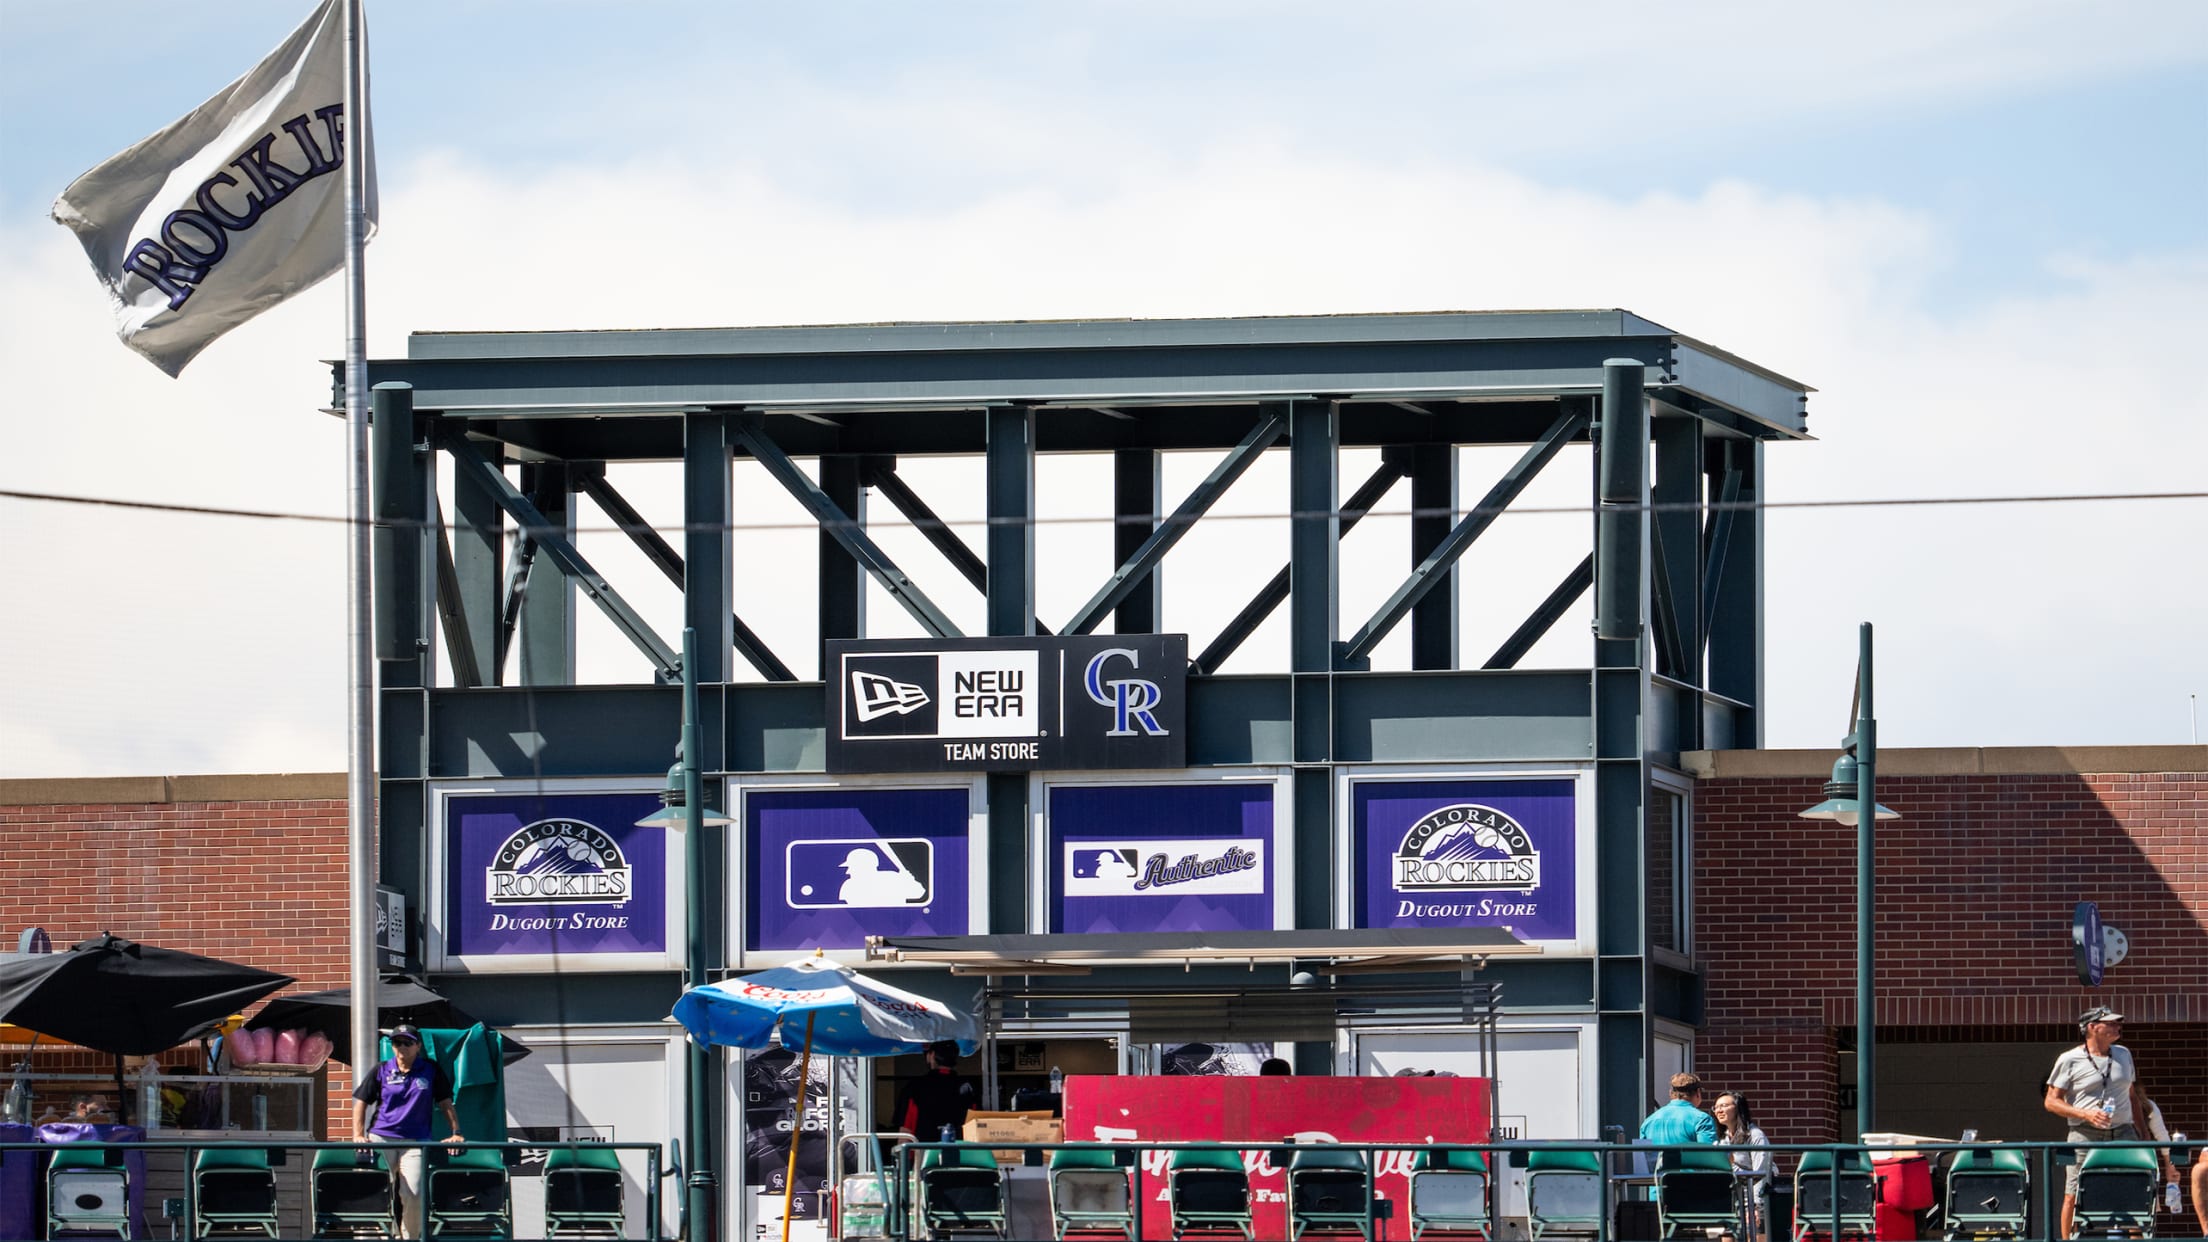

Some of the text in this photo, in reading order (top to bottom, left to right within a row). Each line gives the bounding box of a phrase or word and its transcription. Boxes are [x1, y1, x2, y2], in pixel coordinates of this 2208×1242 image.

[954, 670, 1024, 694] NEW
[954, 694, 1024, 718] ERA
[944, 742, 1039, 761] TEAM STORE
[1407, 808, 1525, 850] COLORADO
[502, 822, 617, 864] COLORADO
[1134, 846, 1257, 891] Authentic
[1399, 858, 1534, 883] ROCKIES
[493, 871, 626, 897] ROCKIES
[743, 982, 826, 1000] Coors
